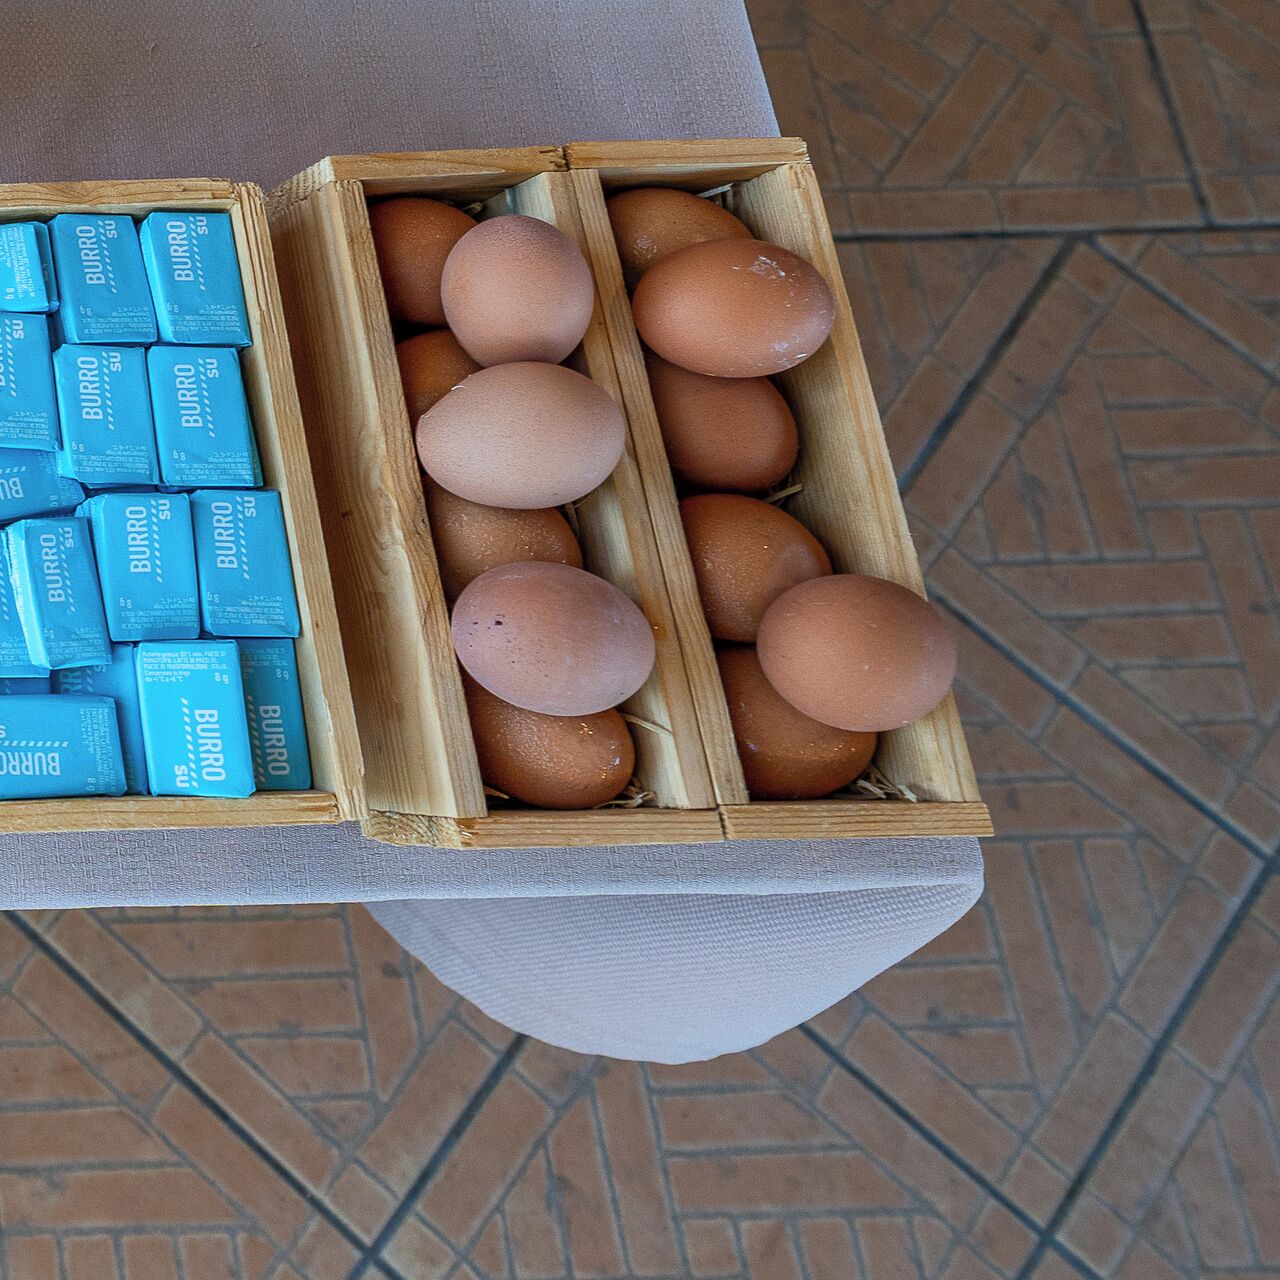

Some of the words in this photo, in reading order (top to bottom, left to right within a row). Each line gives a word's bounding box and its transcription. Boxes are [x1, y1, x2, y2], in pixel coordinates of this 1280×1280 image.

[76, 226, 106, 284] BURRO
[167, 220, 194, 281] BURRO
[77, 357, 103, 419] BURRO
[174, 363, 202, 427] BURRO
[40, 534, 63, 602] BURRO
[126, 506, 151, 573] BURRO
[212, 501, 238, 569] BURRO
[195, 709, 225, 781] BURRO
[259, 706, 290, 775] BURRO
